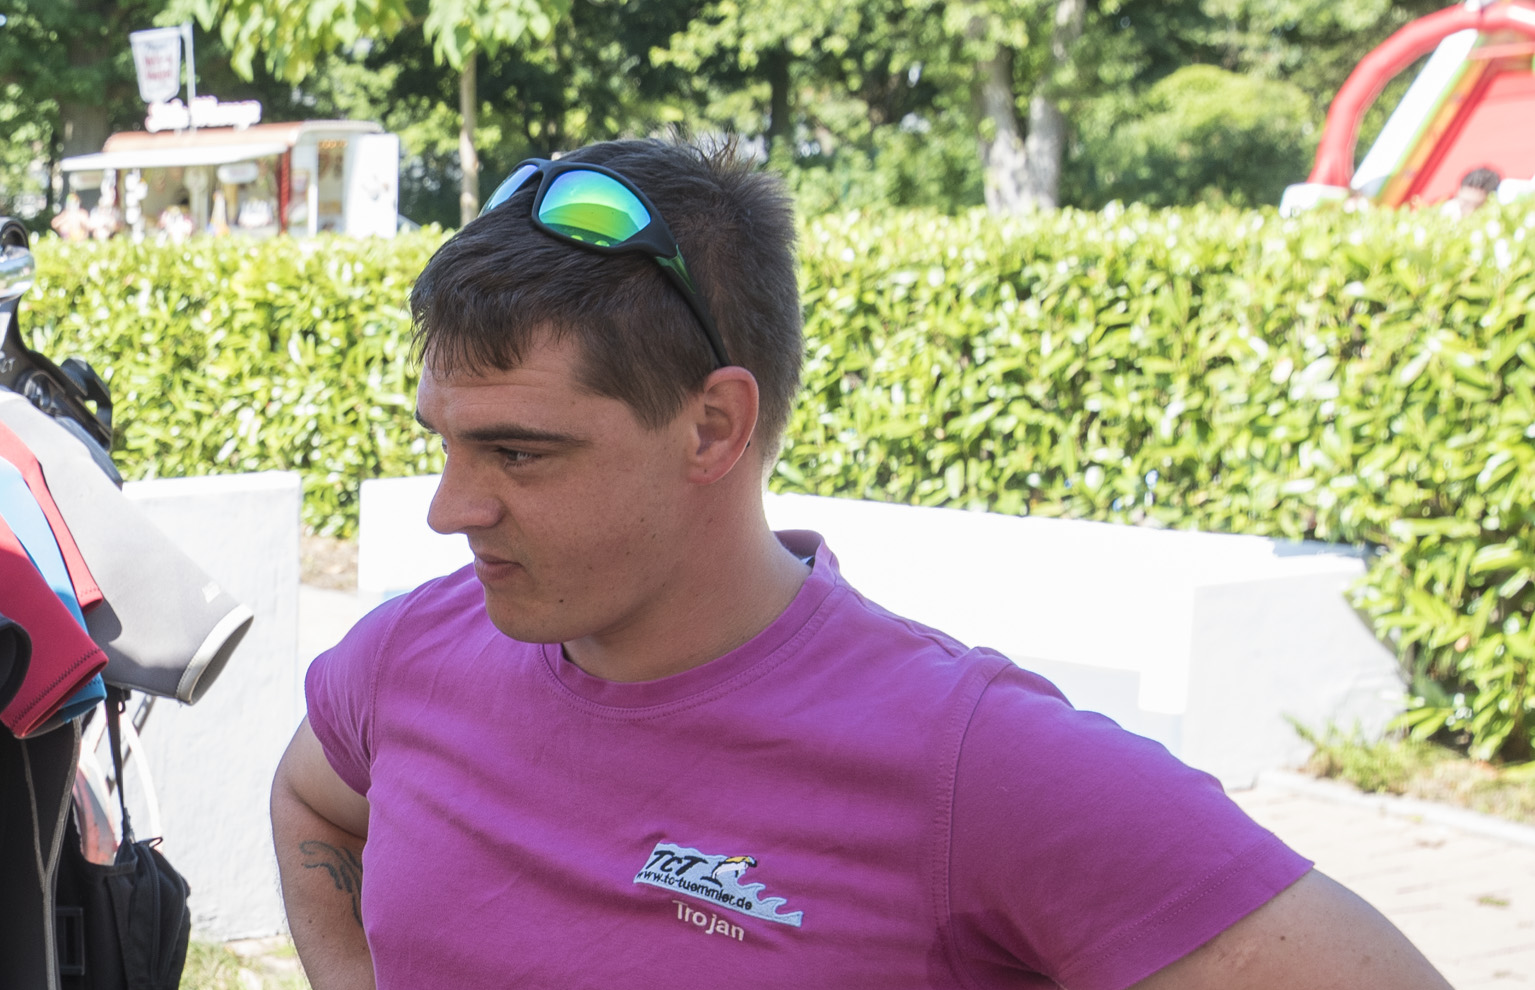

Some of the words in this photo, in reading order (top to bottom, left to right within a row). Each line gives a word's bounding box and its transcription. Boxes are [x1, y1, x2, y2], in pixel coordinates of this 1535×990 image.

[645, 849, 709, 877] TCT
[636, 870, 753, 911] www.tc-tuemmler.de
[672, 899, 745, 942] Trojan
